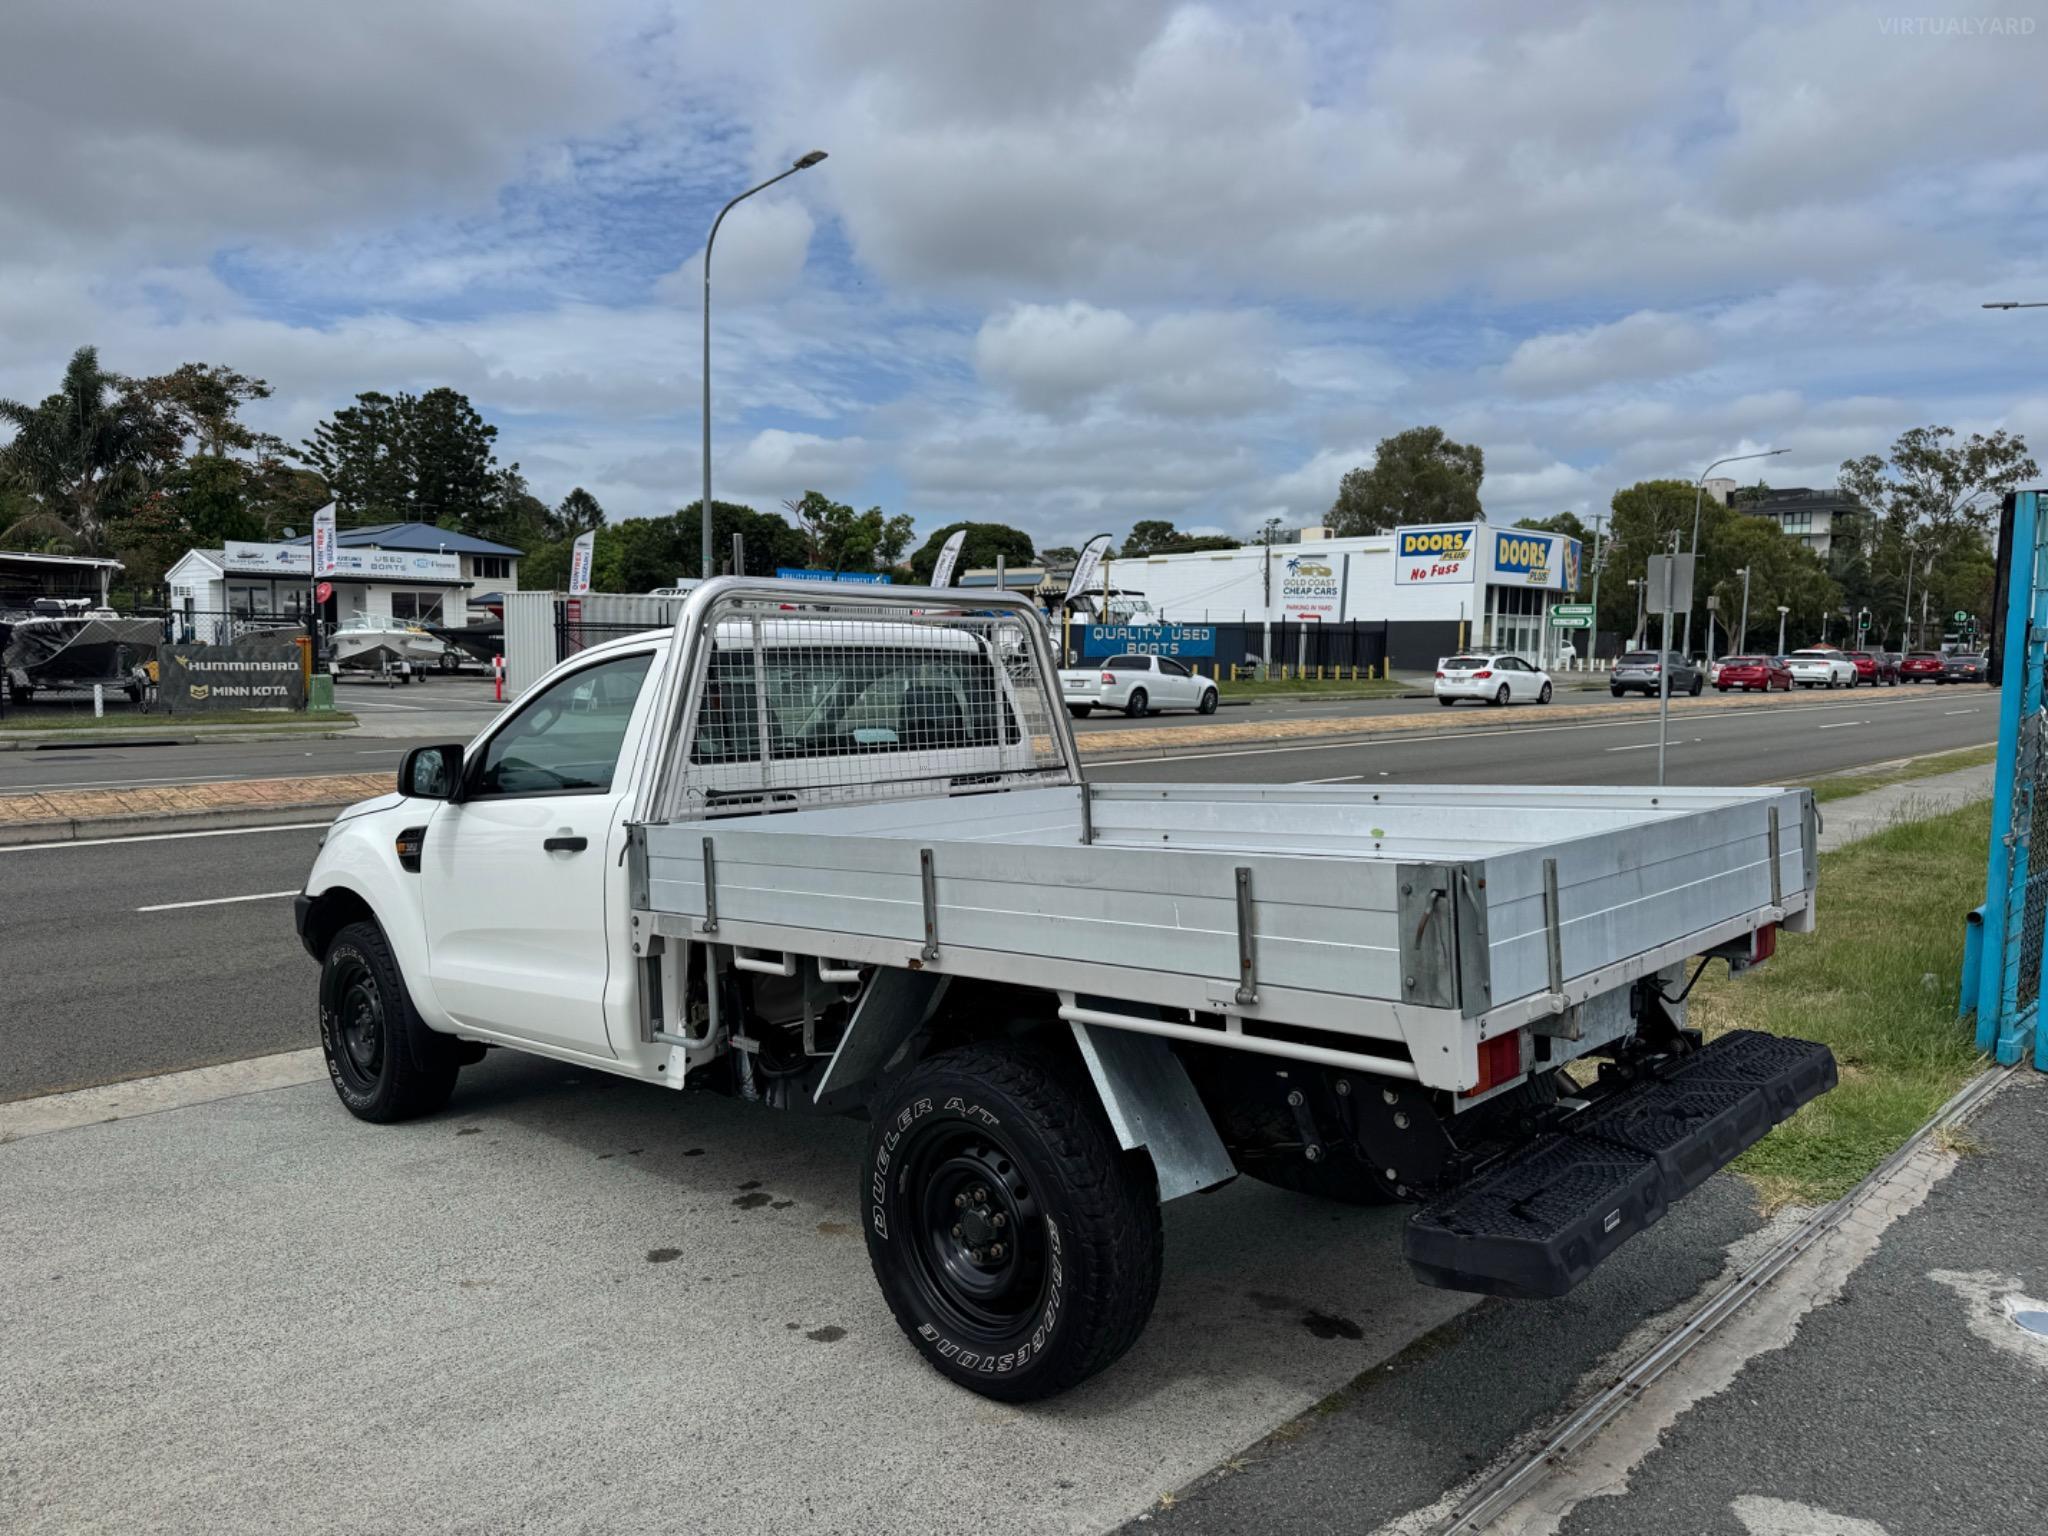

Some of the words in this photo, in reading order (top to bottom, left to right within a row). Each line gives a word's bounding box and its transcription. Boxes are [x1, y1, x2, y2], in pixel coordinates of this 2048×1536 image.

[1405, 533, 1464, 553] DOORS
[317, 528, 325, 572] QUINTREX
[1443, 551, 1467, 560] PLUS
[1499, 538, 1546, 568] DOORS
[374, 555, 402, 563] USED
[370, 563, 407, 571] BOATS
[1530, 570, 1548, 581] PLUS
[1283, 587, 1312, 595] CHEAP
[1314, 587, 1338, 596] CARS
[1318, 604, 1333, 612] YARD
[1093, 627, 1162, 640] QUALITY
[1171, 628, 1210, 640] USED
[1126, 643, 1179, 655] BOATS
[188, 662, 299, 671] HUMMINBIRD
[212, 686, 250, 697] MINN
[252, 686, 288, 696] KOTA
[872, 1098, 933, 1240] DUELER
[944, 1097, 999, 1126] A/T
[917, 1213, 1062, 1373] BRIDGESTONE
